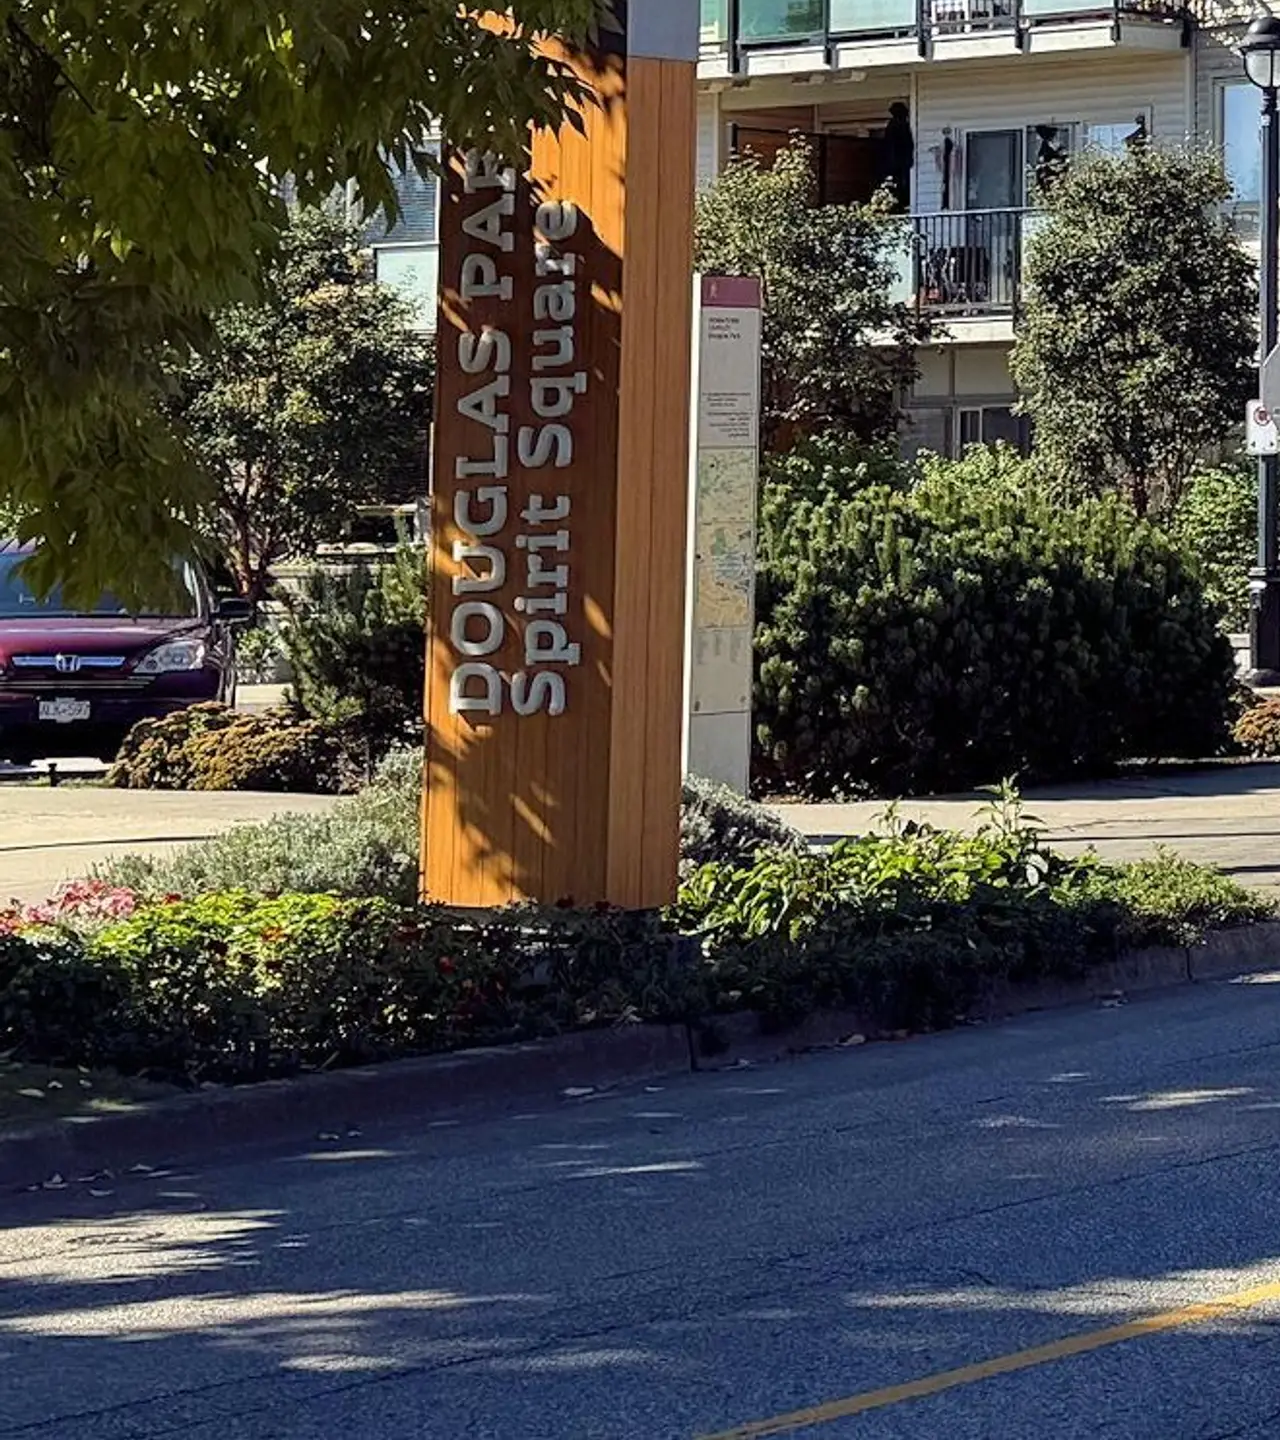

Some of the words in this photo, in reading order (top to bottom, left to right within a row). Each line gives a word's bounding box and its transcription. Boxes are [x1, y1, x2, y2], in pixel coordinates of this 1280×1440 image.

[517, 199, 588, 468] Square
[449, 328, 511, 716] DOUGLAS
[510, 494, 582, 716] Spirit
